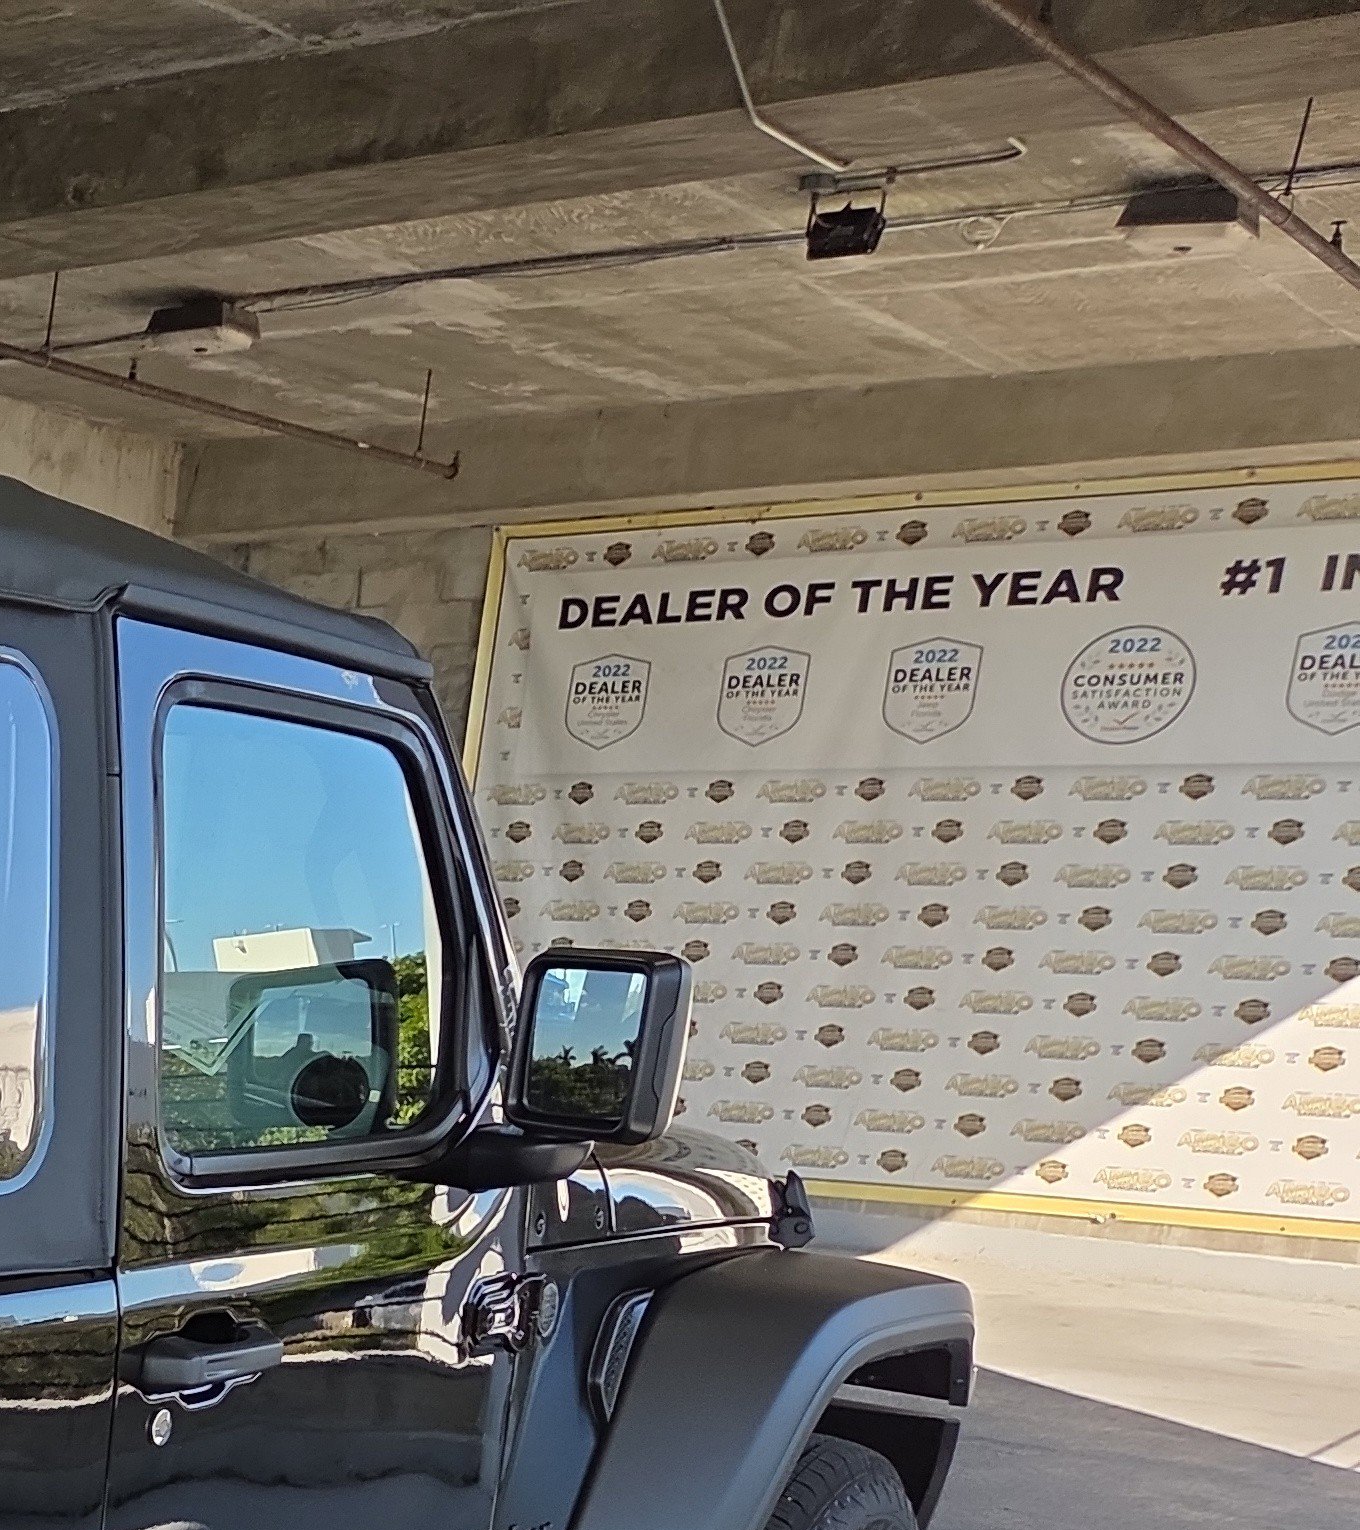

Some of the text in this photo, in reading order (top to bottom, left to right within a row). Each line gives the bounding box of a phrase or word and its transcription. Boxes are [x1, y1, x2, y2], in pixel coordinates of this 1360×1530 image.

[1219, 556, 1287, 597] #1
[557, 566, 1125, 630] DEALER OF THE YEAR
[1108, 637, 1162, 654] 2022
[745, 656, 788, 671] 2022
[913, 648, 959, 664] 2022
[592, 664, 631, 678] 2022
[893, 667, 972, 683] DEALER
[1297, 671, 1316, 681] OF
[1321, 671, 1349, 681] THE
[574, 680, 642, 695] DEALER
[727, 673, 801, 689] DEALER
[1073, 672, 1185, 688] CONSUMER
[726, 689, 799, 699] OF THE YEAR
[891, 683, 970, 694] OF THE YEAR
[1071, 688, 1183, 700] SATISFACTION
[572, 695, 641, 705] OF THE YEAR
[1097, 700, 1151, 710] AWARD
